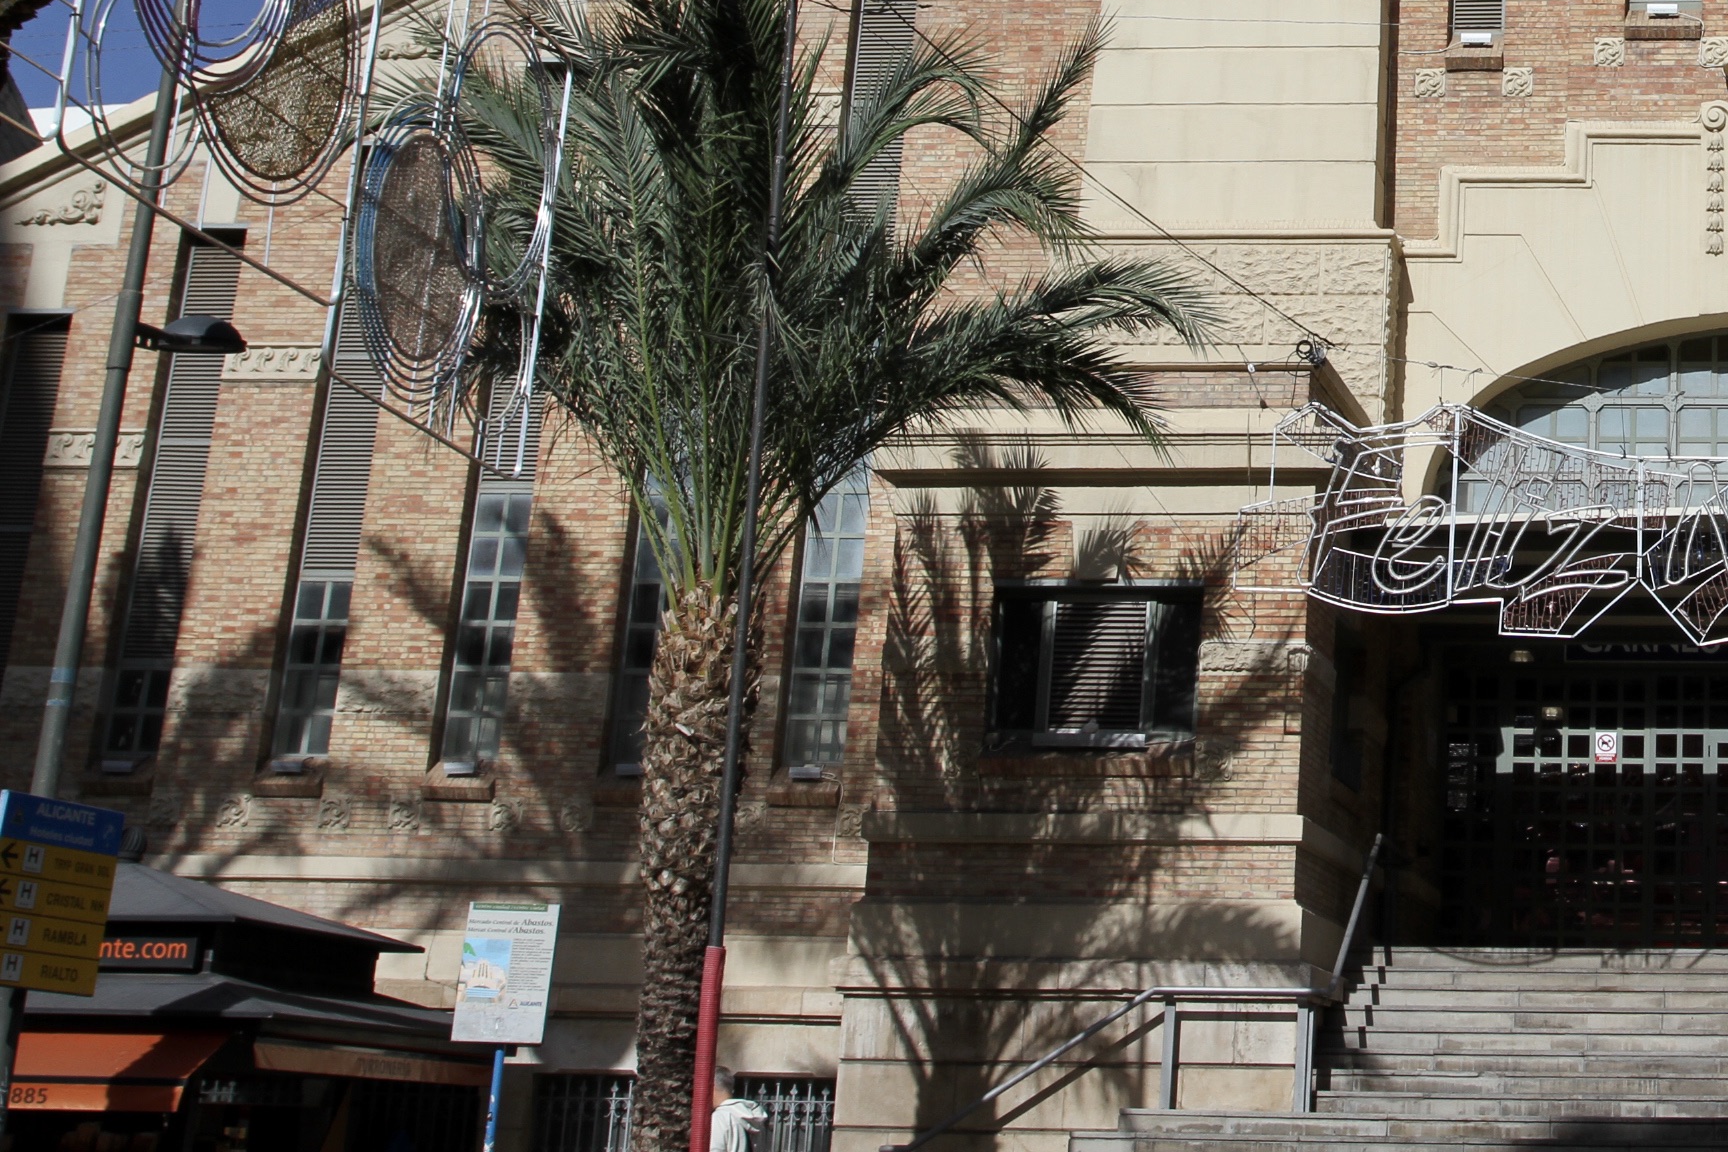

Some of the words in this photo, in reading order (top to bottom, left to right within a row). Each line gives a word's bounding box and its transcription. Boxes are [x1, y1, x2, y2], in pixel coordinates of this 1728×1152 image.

[1297, 430, 1629, 602] Feliz
[36, 802, 97, 827] ALICANTE
[46, 892, 85, 910] CRISTAL
[42, 927, 88, 947] RAMBLA
[98, 937, 188, 959] nte.com
[40, 964, 78, 982] RIALTO
[10, 1087, 48, 1104] 885
